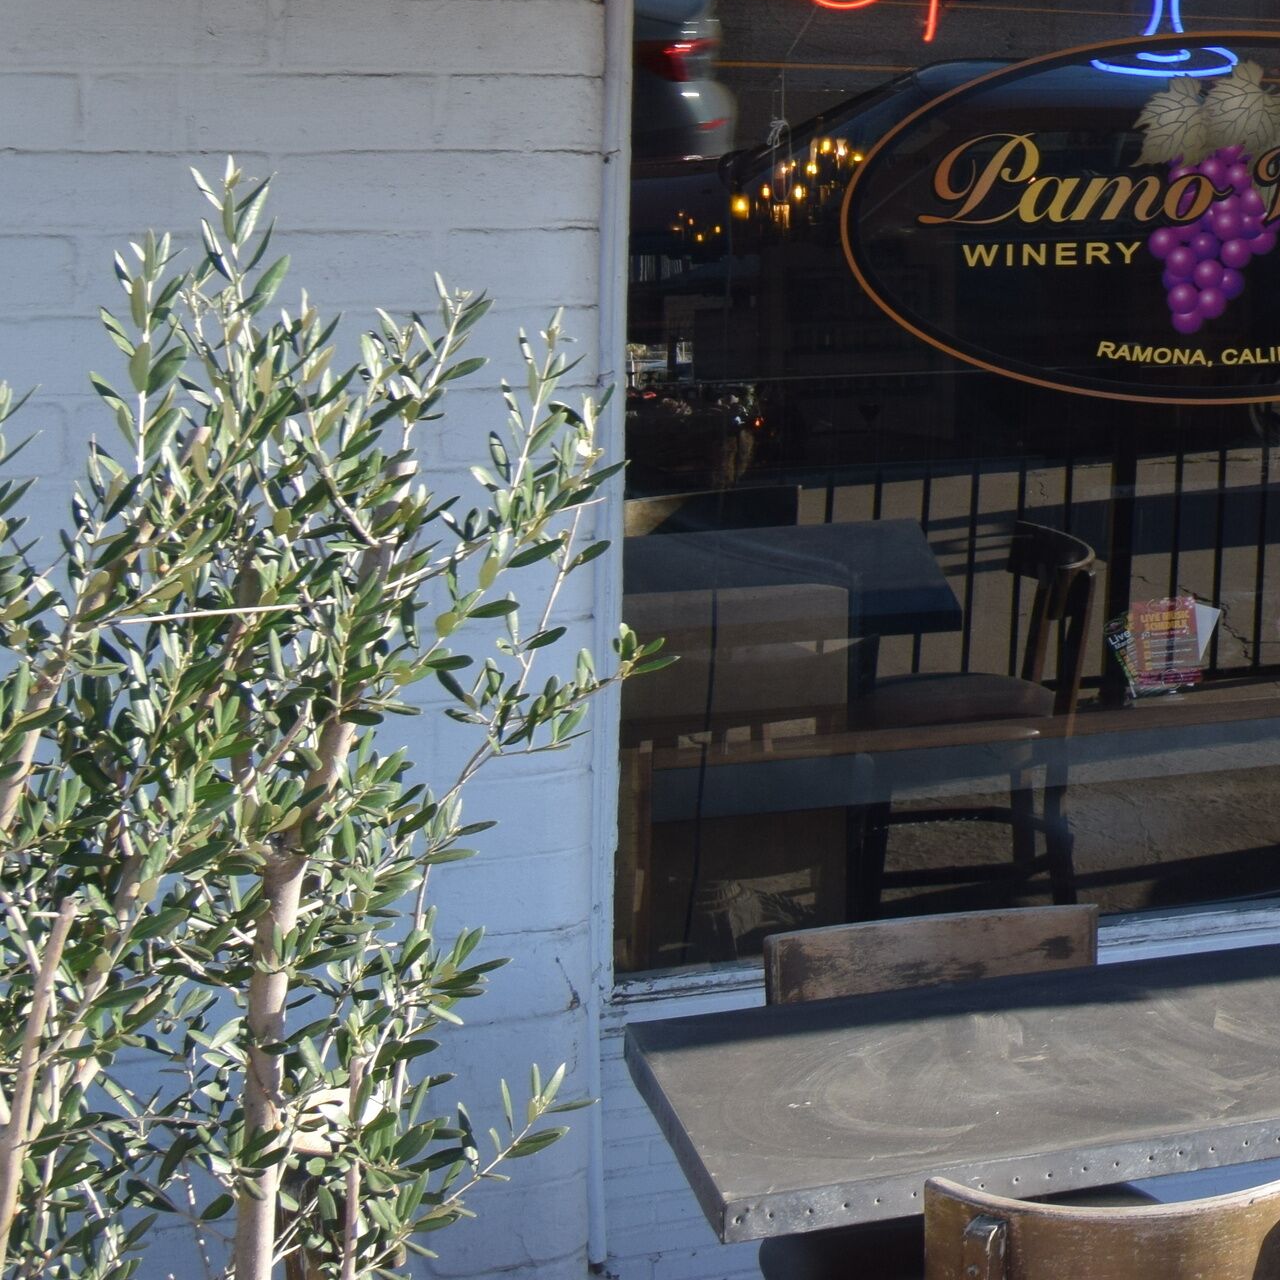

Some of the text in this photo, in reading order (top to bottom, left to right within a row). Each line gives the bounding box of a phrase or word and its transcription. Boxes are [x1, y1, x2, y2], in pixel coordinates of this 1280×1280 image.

[918, 132, 1231, 228] Pamo
[961, 240, 1142, 268] WINERY
[1096, 340, 1215, 369] RAMONA,
[1140, 610, 1189, 623] LIVE MUSIC
[1108, 630, 1131, 645] Live
